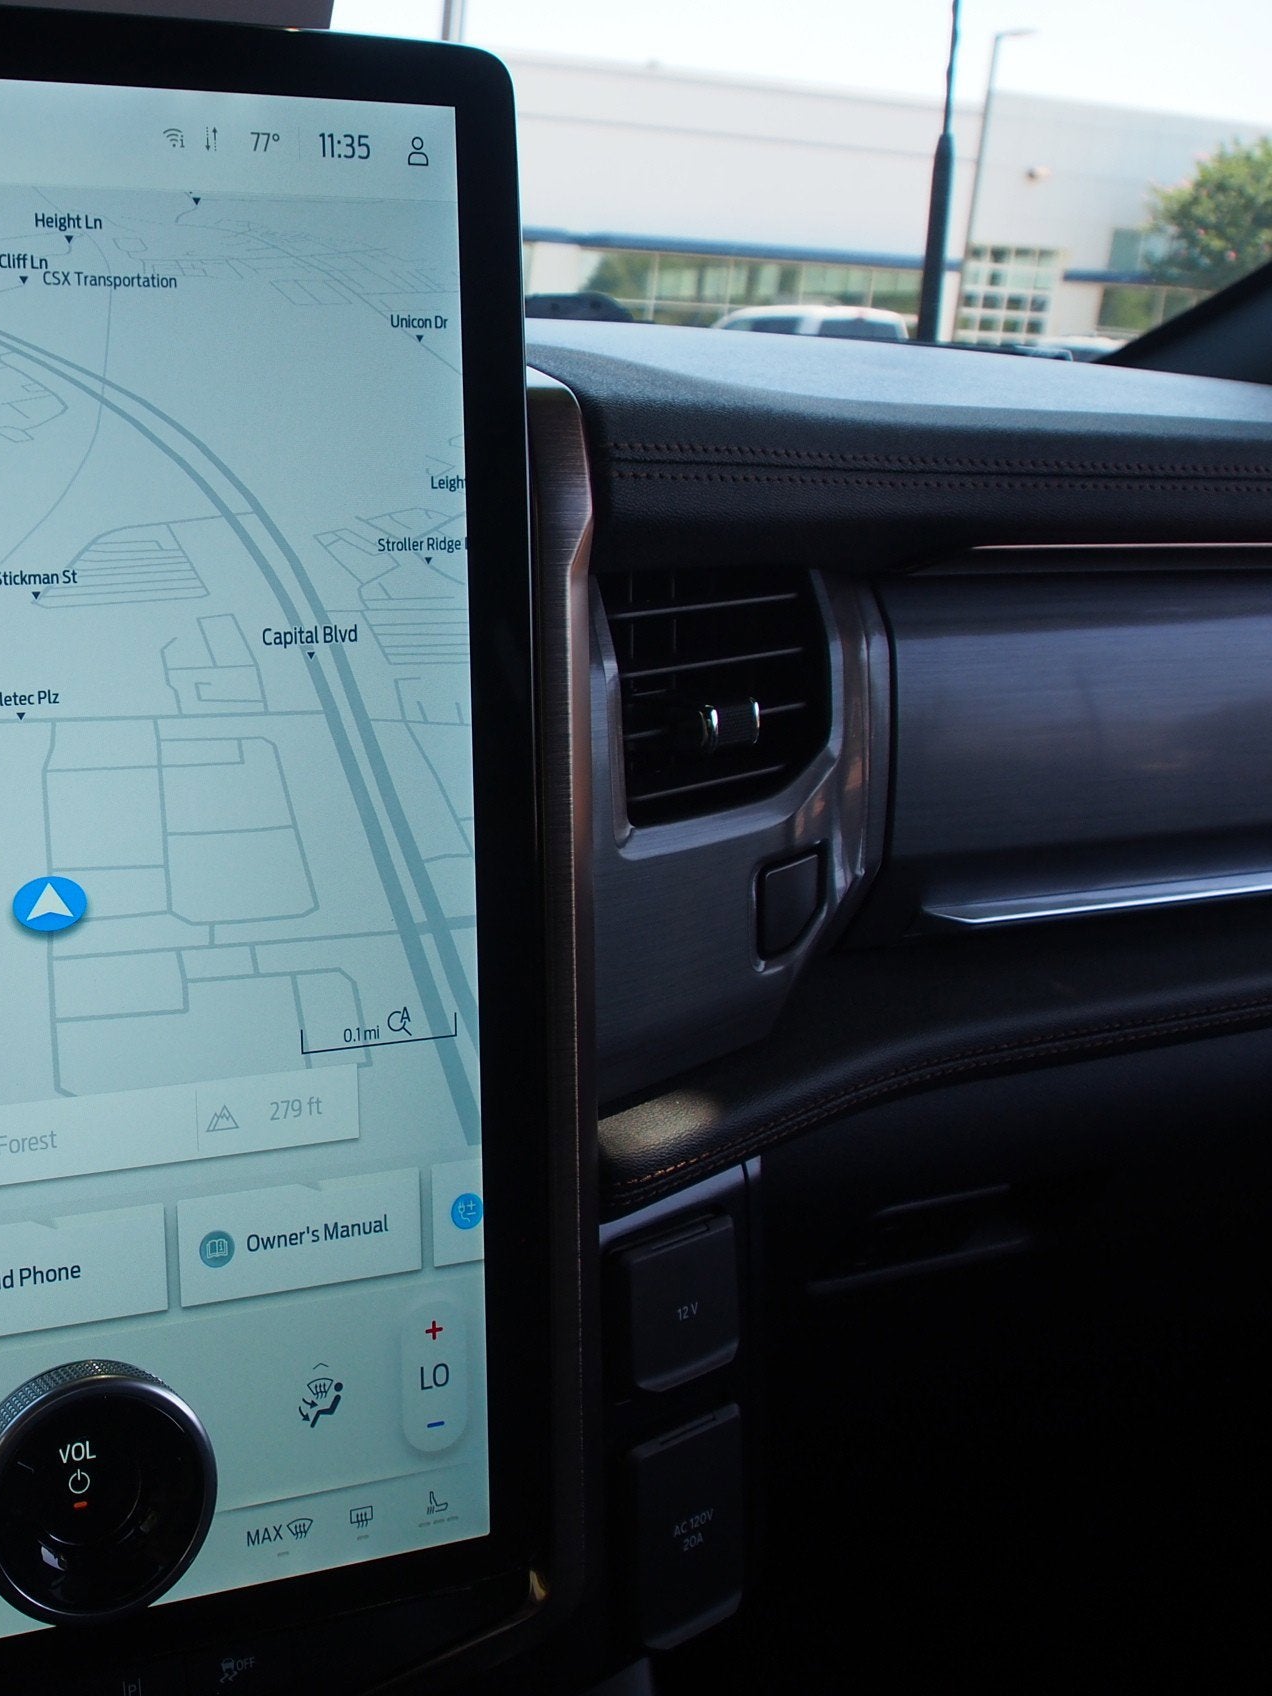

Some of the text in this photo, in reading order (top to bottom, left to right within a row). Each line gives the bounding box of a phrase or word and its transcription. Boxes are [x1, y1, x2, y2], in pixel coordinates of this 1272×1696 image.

[319, 132, 371, 160] 11:35
[34, 212, 103, 231] Height Ln
[30, 254, 49, 270] Ln
[42, 270, 178, 290] CSX Transportation
[390, 313, 449, 330] Unicon Dr
[377, 537, 424, 552] Stroller
[428, 537, 462, 553] Ridge
[62, 569, 78, 584] St
[262, 624, 359, 648] Capital Blvd
[37, 689, 60, 705] Plz
[343, 1025, 380, 1043] 0.1 mi
[269, 1096, 323, 1121] 279 ft
[246, 1214, 389, 1253] Owner's Manual
[19, 1262, 81, 1288] Phone
[420, 1362, 450, 1391] LO
[59, 1440, 96, 1464] VOL
[673, 1507, 714, 1538] AC 120V
[246, 1523, 283, 1547] MAX
[683, 1531, 704, 1552] 20A
[237, 1656, 256, 1672] OFF
